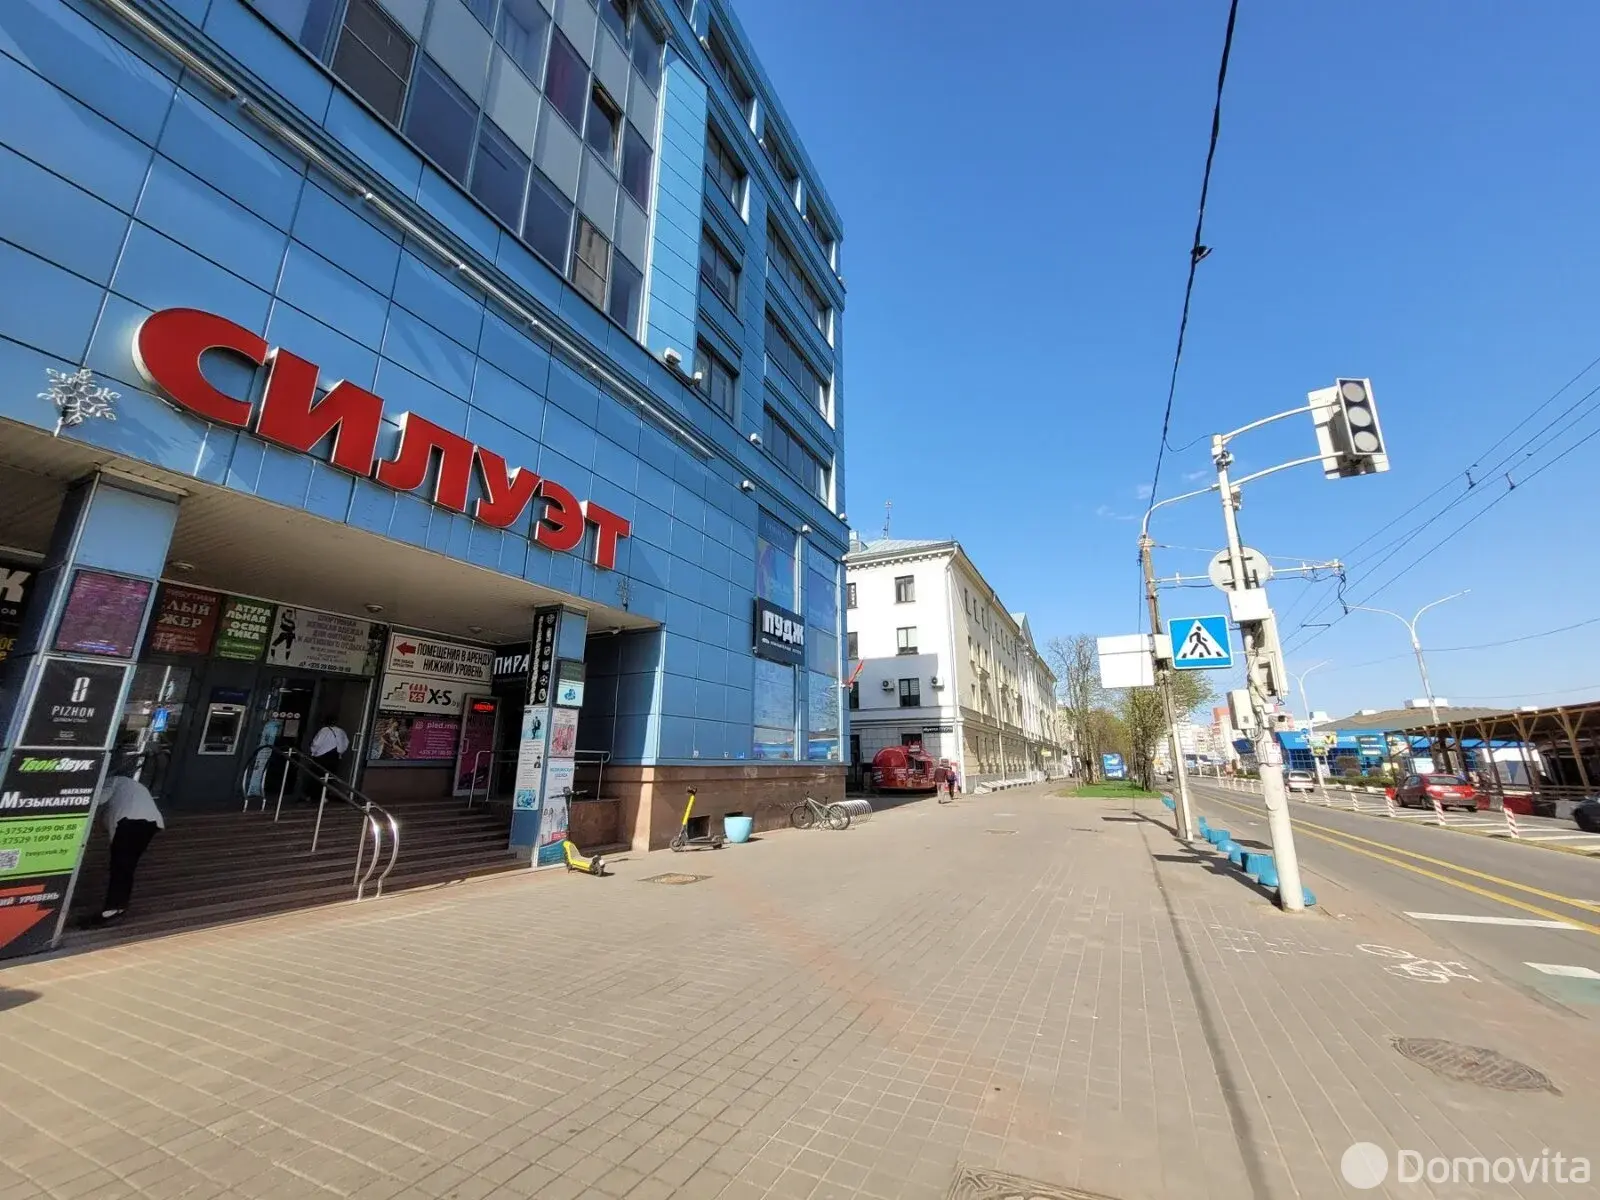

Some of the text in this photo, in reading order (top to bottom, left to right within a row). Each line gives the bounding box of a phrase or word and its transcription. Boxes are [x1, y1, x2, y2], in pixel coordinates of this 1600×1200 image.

[132, 307, 630, 570] СИЛУЭТ
[762, 610, 804, 646] ПУДЖ
[417, 643, 491, 666] ПОМЕЩЕНИЯ В АРЕНДУ
[423, 658, 454, 674] НИЖНИЙ
[454, 663, 483, 677] УРОВЕНЬ
[51, 705, 95, 718] PIZHON
[0, 836, 31, 845] 37529
